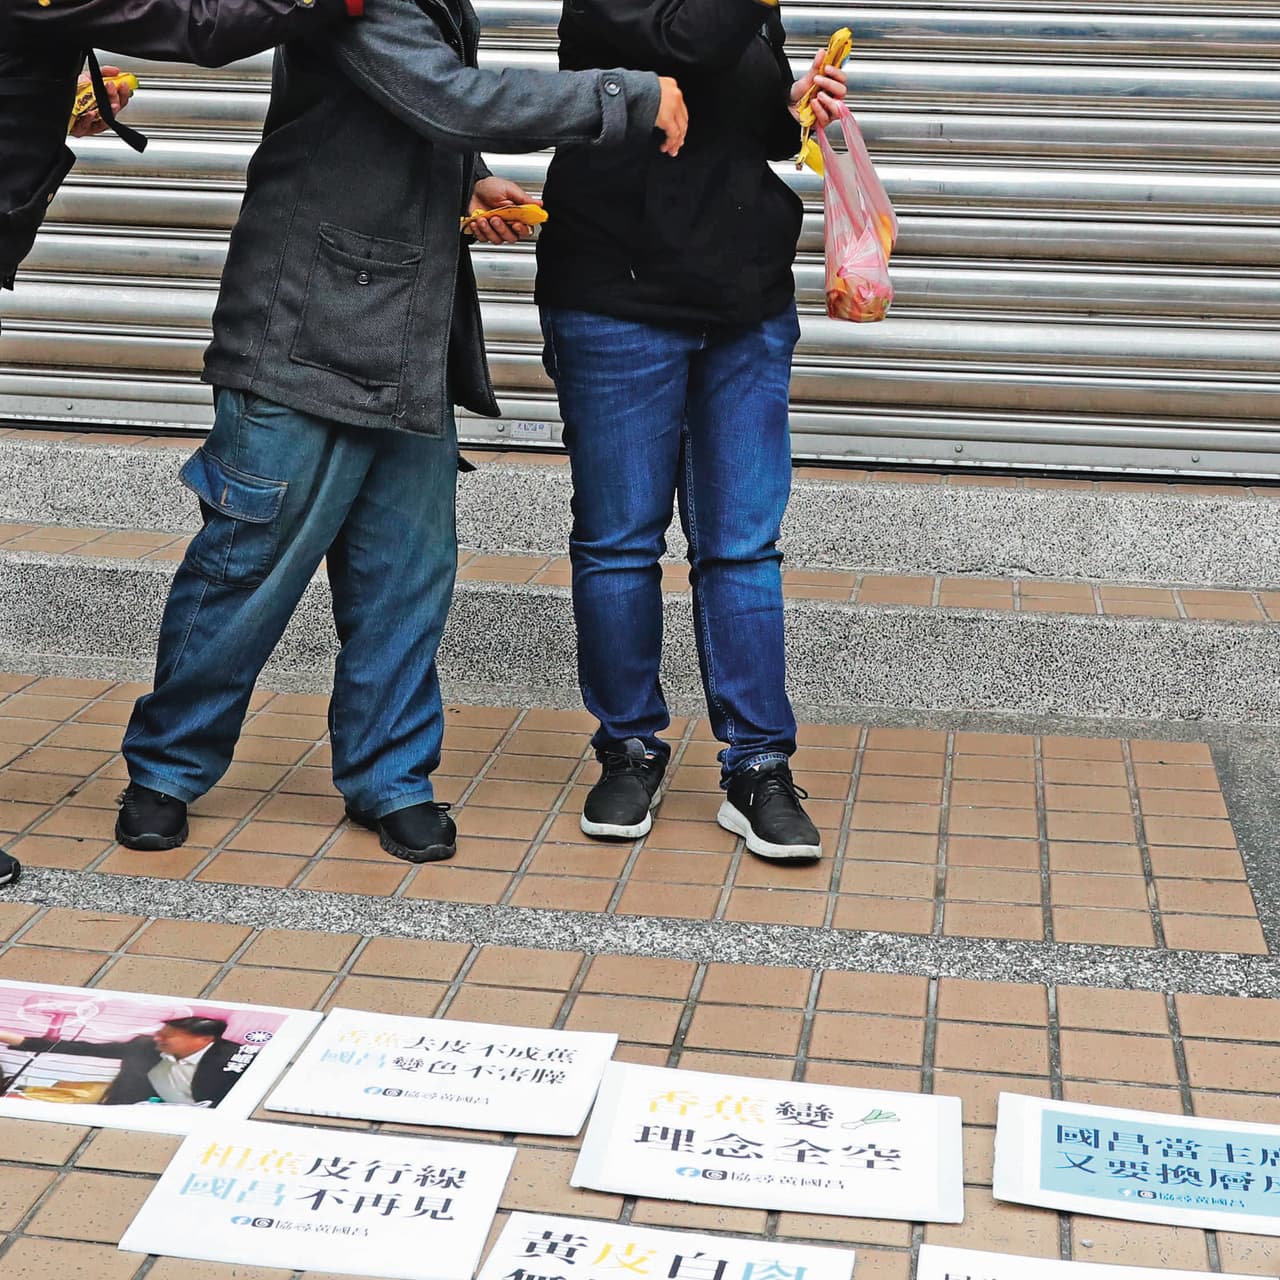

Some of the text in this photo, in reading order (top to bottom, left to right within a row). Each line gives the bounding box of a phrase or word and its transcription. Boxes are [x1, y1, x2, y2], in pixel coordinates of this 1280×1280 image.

[648, 1089, 835, 1129] 香蕉變
[633, 1123, 903, 1172] 理念全空
[178, 1172, 455, 1222] 國昌不再見
